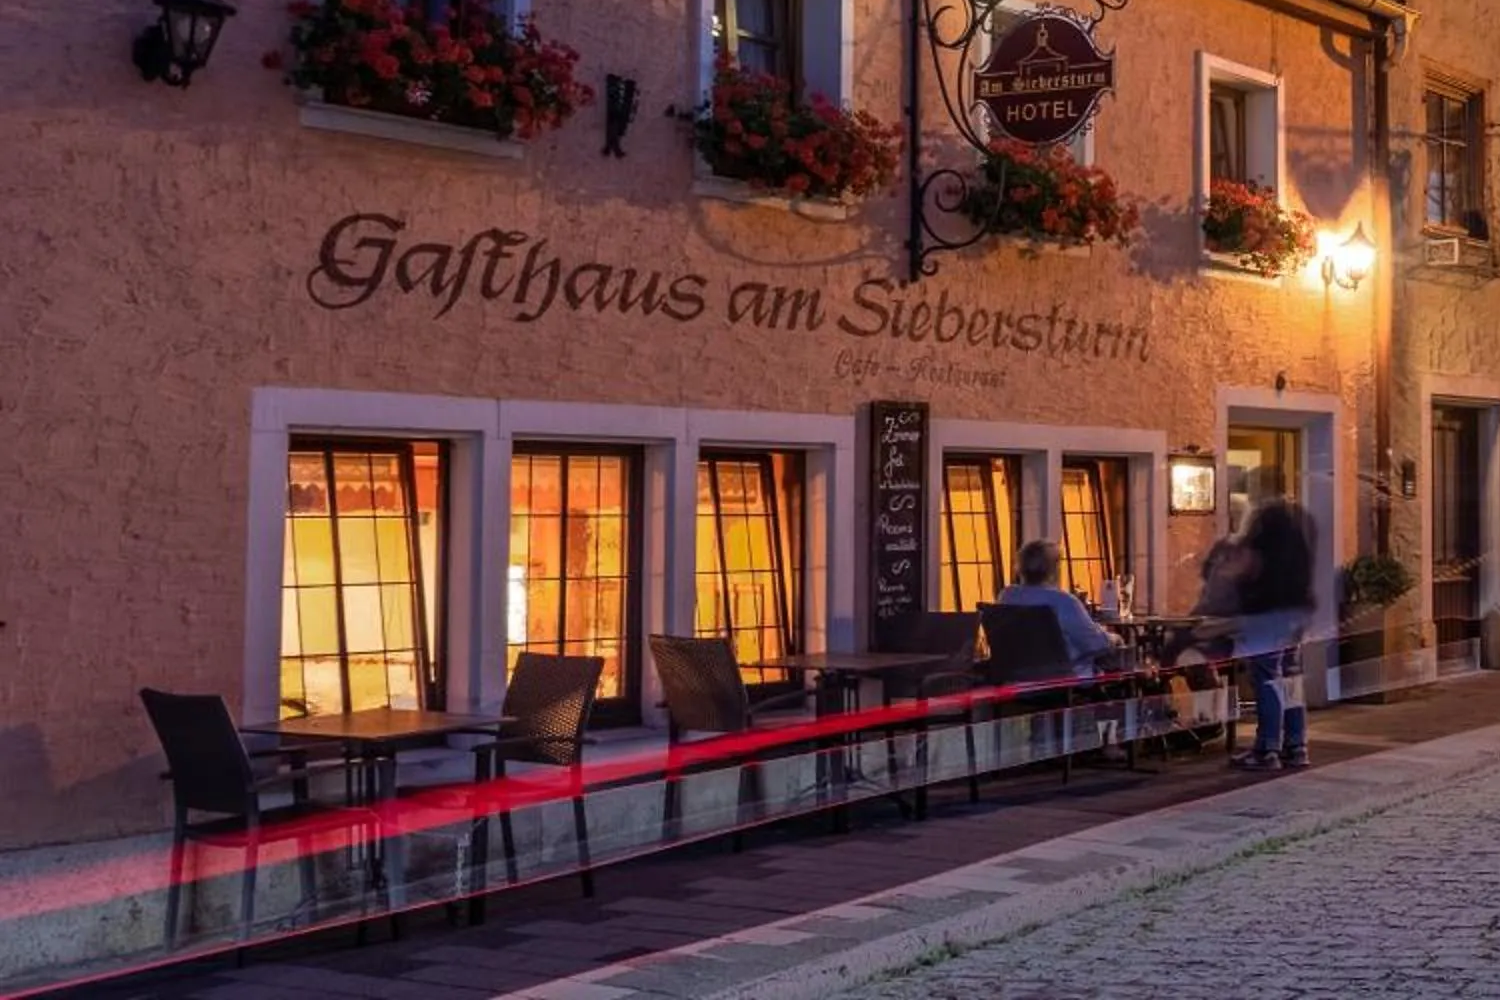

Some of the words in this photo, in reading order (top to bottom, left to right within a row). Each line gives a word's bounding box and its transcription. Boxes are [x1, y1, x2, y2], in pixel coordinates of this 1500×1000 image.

[1006, 101, 1079, 121] HOTEL
[727, 281, 826, 332] am
[837, 279, 1150, 363] Siebersturm
